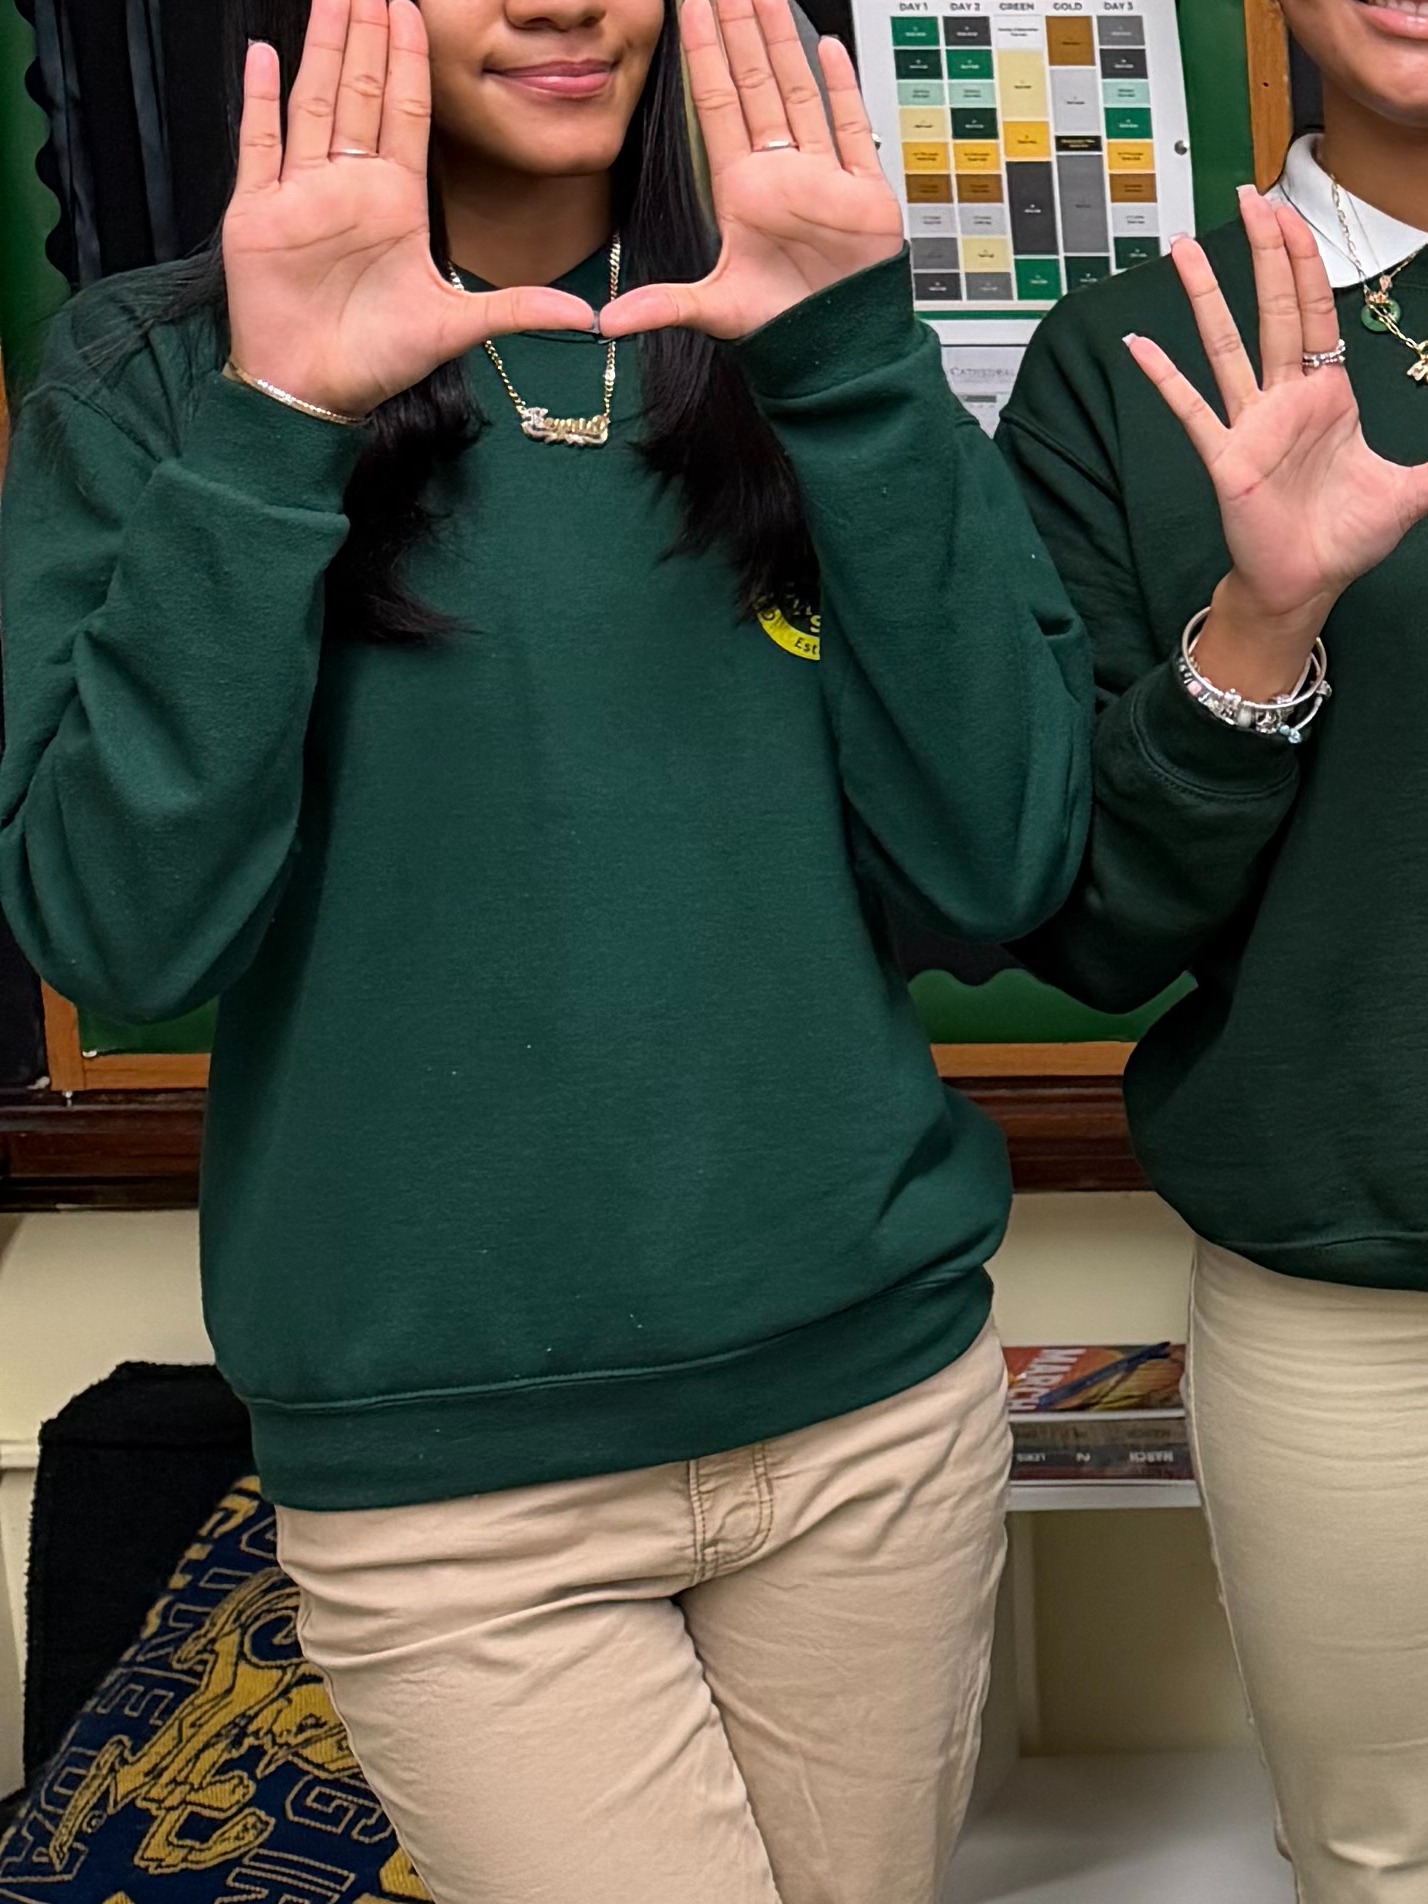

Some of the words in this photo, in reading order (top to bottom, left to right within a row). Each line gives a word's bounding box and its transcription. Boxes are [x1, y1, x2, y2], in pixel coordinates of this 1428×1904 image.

[899, 2, 920, 12] DAY
[950, 2, 971, 12] DAY
[998, 1, 1035, 12] GREEN
[1053, 1, 1083, 11] GOLD
[1103, 0, 1125, 11] DAY
